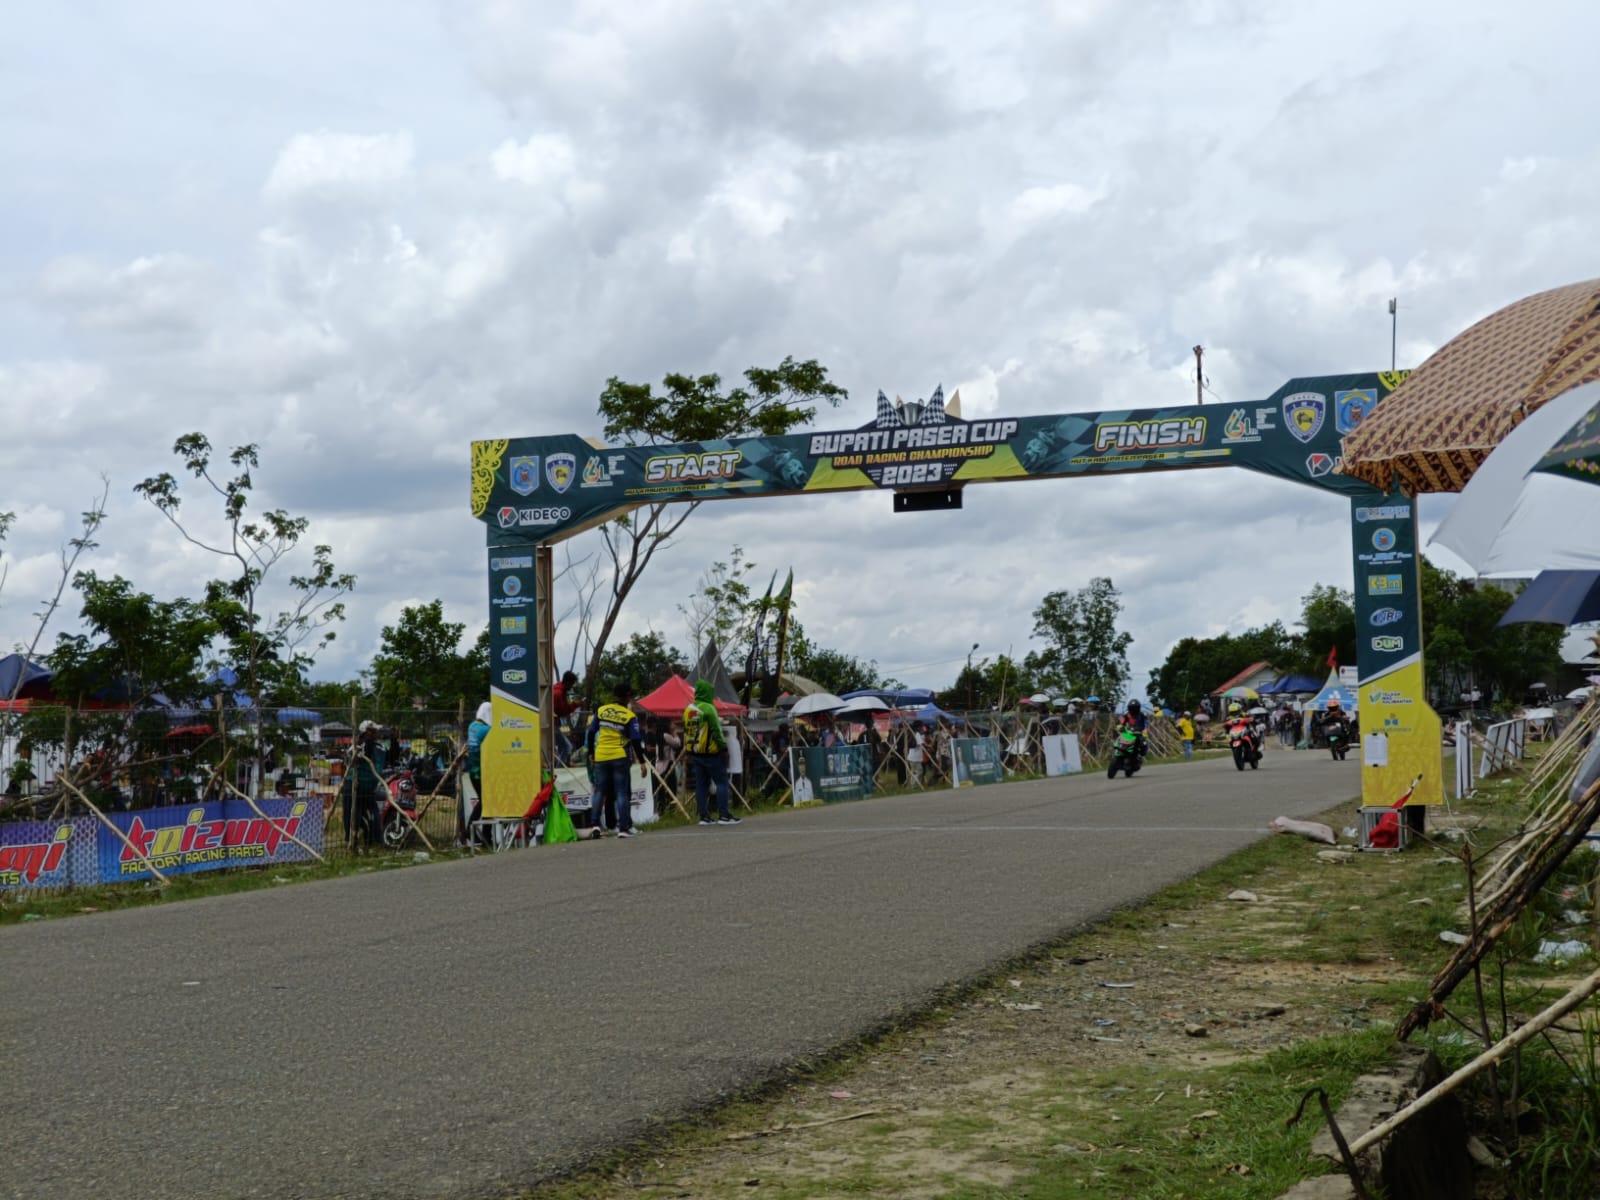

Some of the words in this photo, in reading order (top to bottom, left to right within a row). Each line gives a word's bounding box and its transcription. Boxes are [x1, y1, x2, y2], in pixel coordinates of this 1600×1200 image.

[810, 431, 889, 454] BUPATI
[893, 425, 968, 448] PASER
[971, 421, 1018, 442] CUP
[1097, 419, 1204, 449] FINISH
[646, 452, 741, 482] START
[833, 454, 863, 467] ROAD
[866, 451, 907, 464] RACING
[910, 445, 993, 461] CHAMPIONSHIP
[881, 463, 943, 485] 2023
[520, 508, 570, 521] KIDECO
[1374, 639, 1401, 649] DUM
[185, 850, 227, 865] RACING
[229, 845, 265, 858] PARTS
